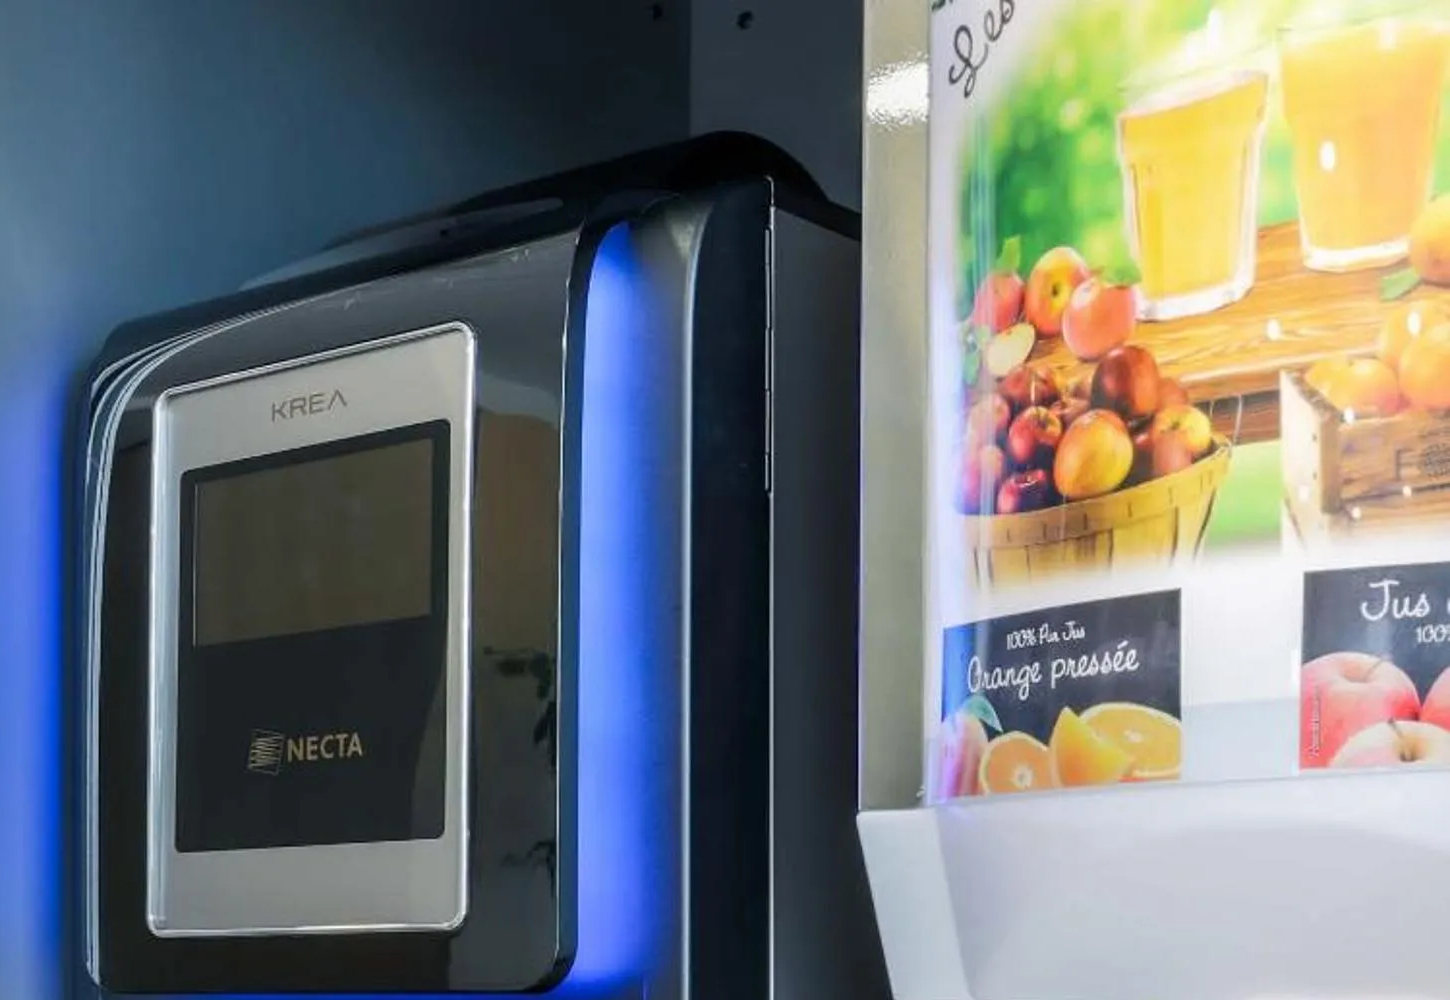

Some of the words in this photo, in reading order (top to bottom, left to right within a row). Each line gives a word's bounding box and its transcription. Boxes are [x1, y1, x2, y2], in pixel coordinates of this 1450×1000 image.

[271, 389, 348, 422] KREA
[1360, 579, 1430, 620] Jus
[1006, 626, 1037, 650] 100%
[1062, 620, 1086, 641] Jus
[967, 655, 1042, 701] Orange
[1051, 640, 1140, 689] pressée
[287, 731, 363, 762] NECTA
